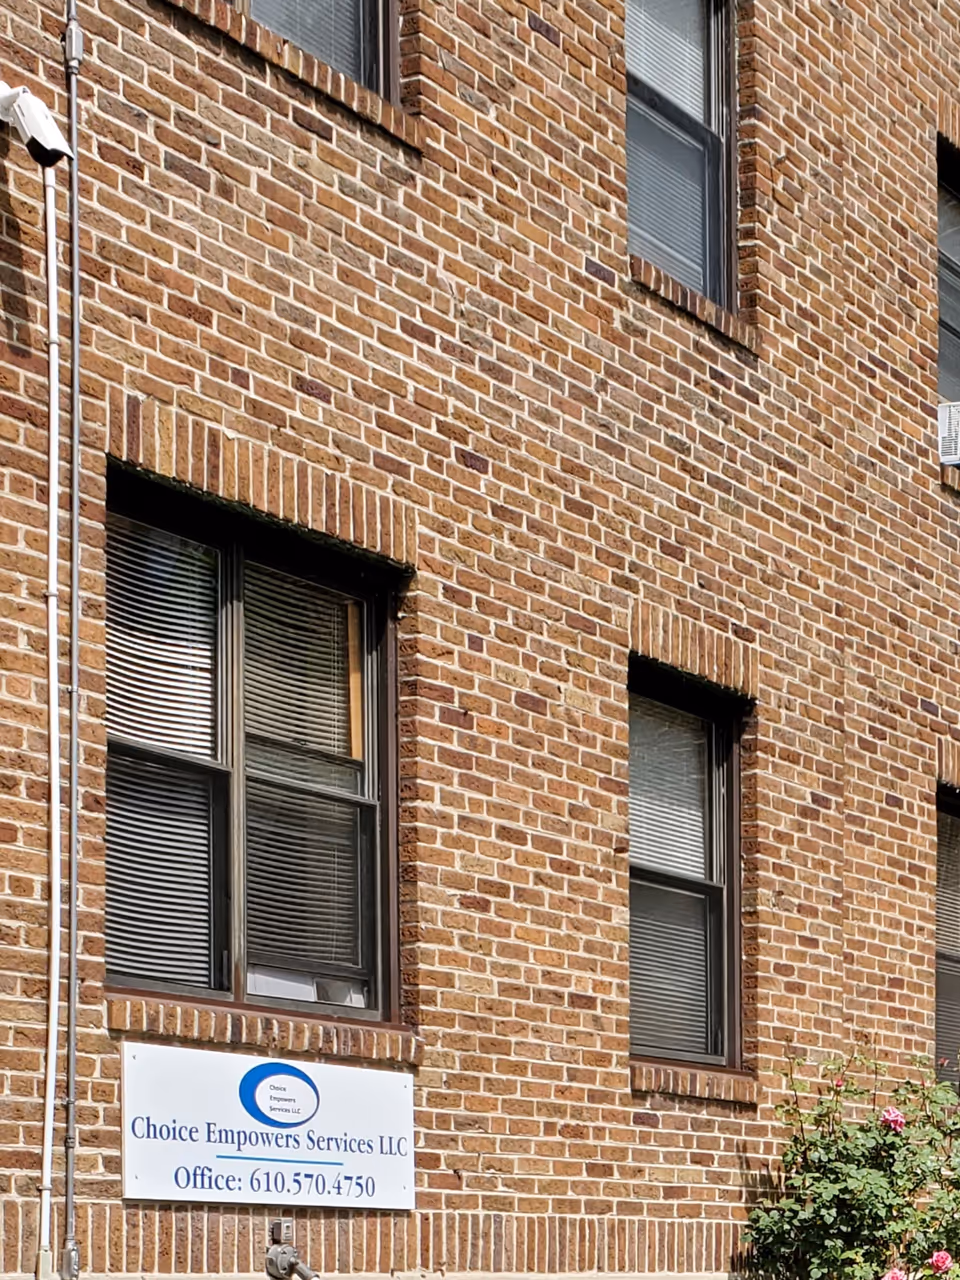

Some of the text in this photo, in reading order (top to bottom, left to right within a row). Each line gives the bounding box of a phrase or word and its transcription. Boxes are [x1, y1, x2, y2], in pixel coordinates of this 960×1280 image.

[131, 1116, 408, 1157] Choice Empowers Services LLC
[174, 1166, 376, 1198] Office: 610.570.4750
